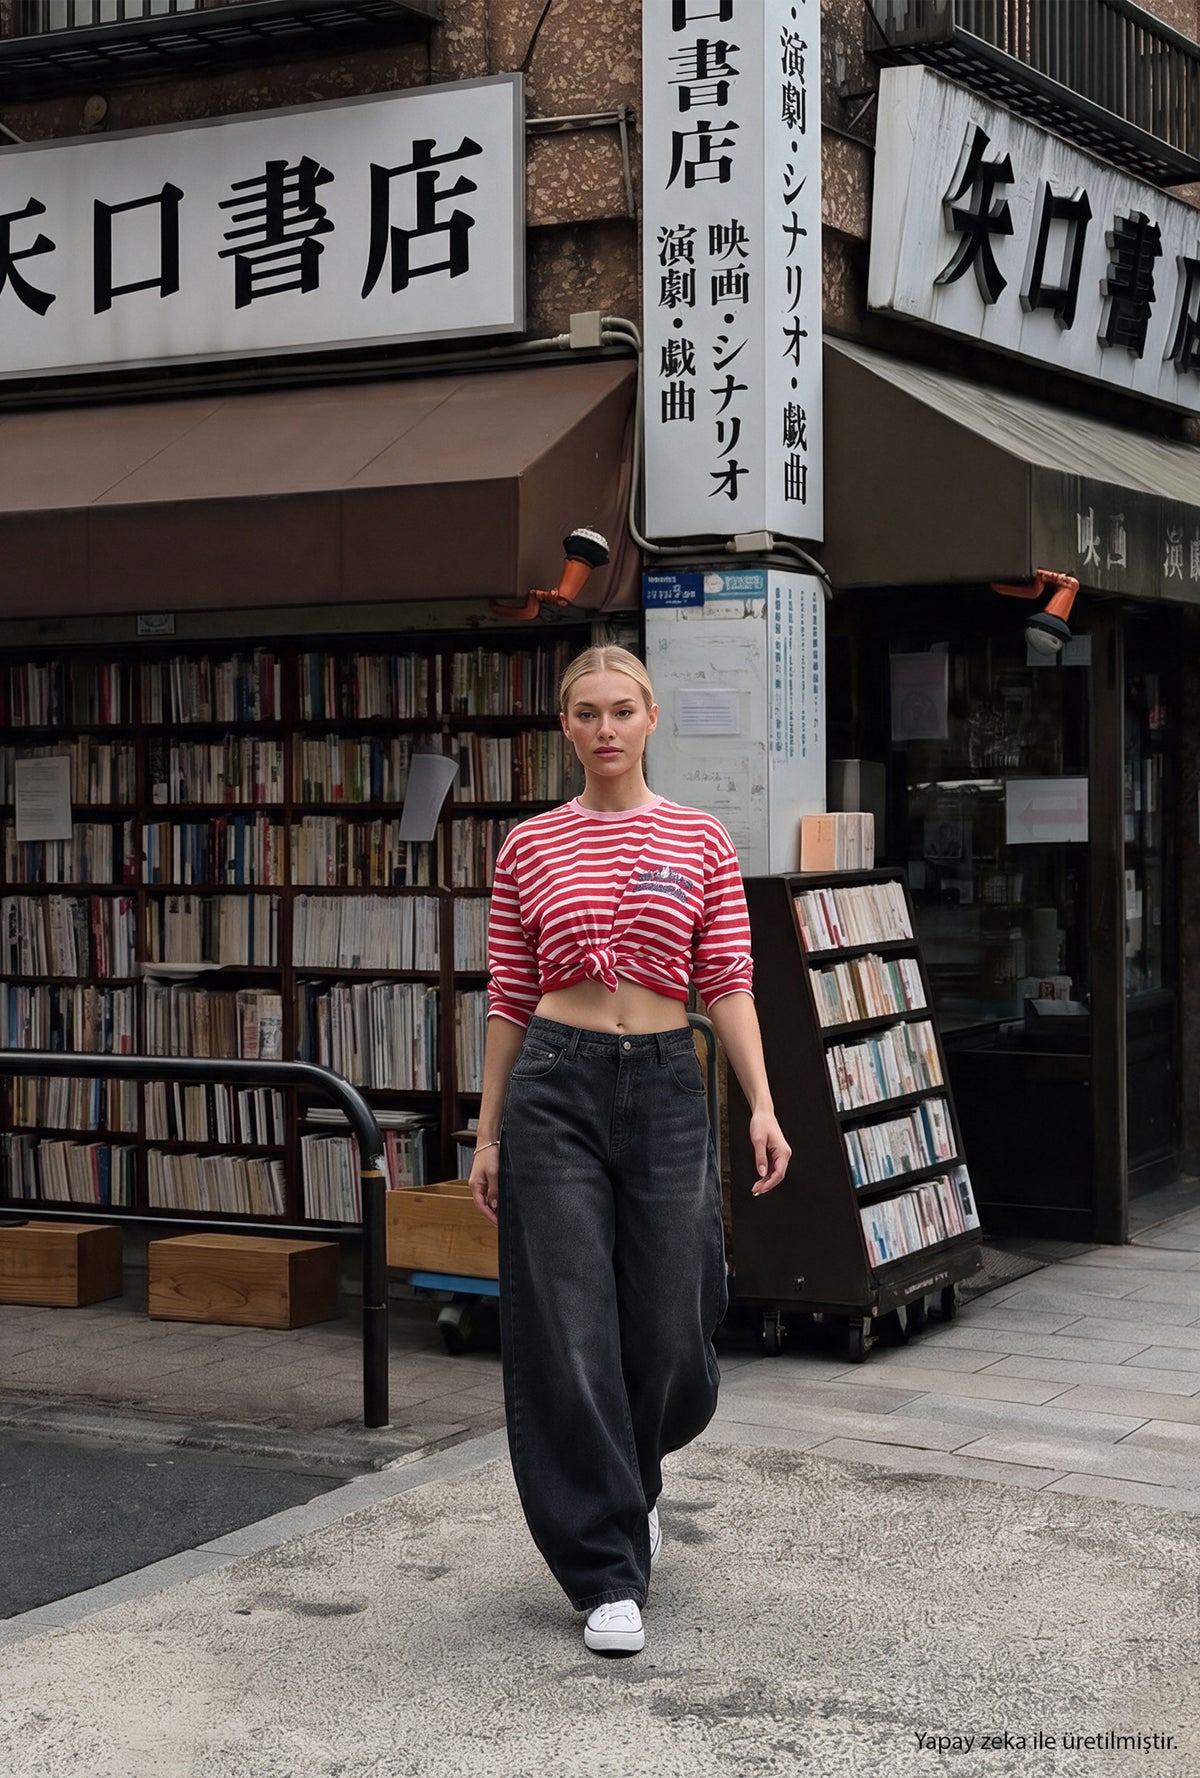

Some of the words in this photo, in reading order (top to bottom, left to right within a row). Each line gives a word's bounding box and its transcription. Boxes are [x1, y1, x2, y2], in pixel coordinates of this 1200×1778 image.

[657, 223, 697, 424] 演劇・戯曲
[707, 218, 750, 502] 映画・シナリオ
[780, 0, 809, 505] ・演劇・シナリオ・戯曲
